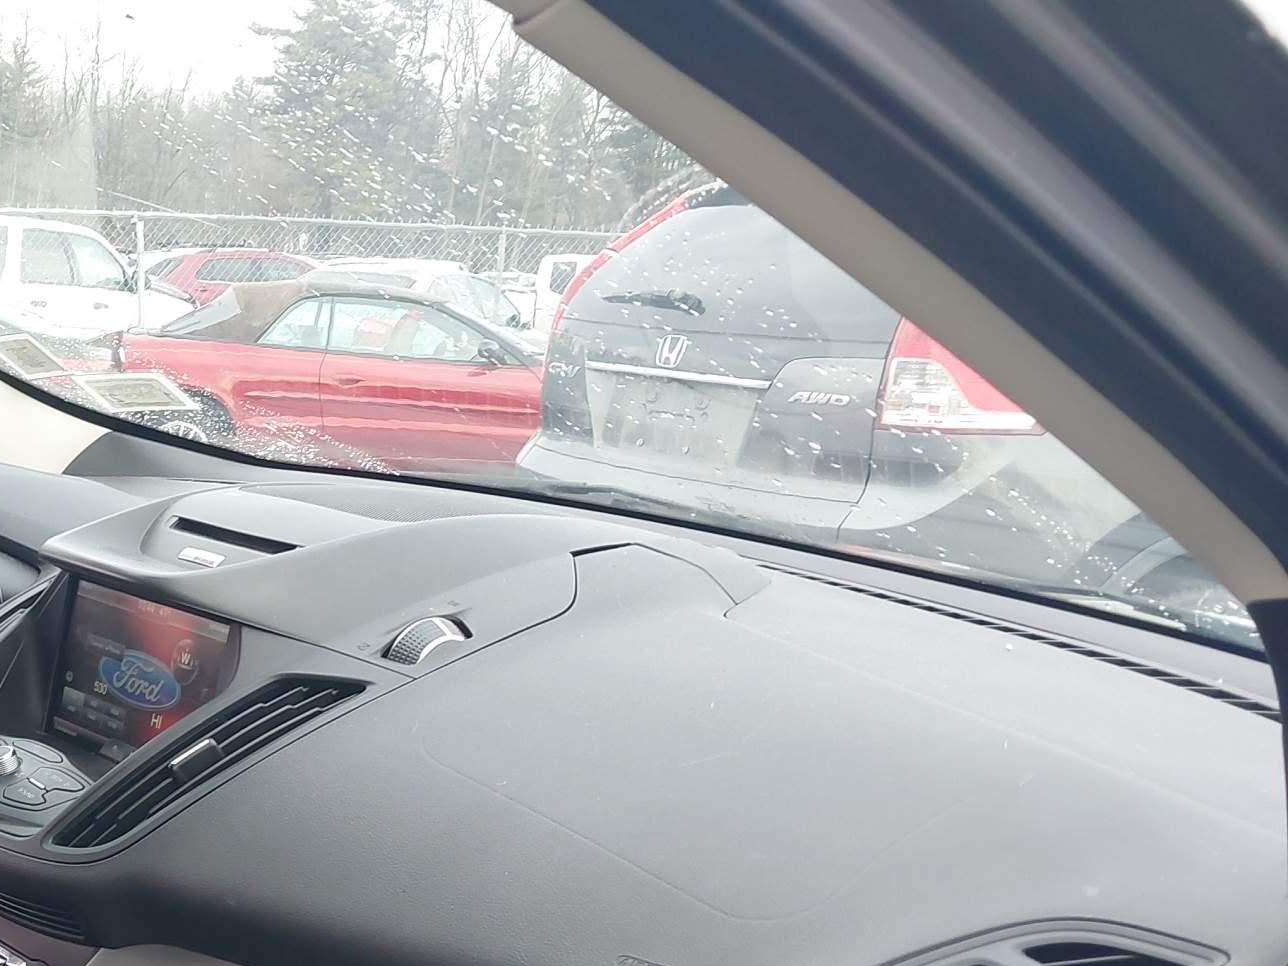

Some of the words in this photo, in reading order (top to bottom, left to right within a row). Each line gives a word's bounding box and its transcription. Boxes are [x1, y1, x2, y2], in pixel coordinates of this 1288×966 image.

[788, 391, 851, 406] AWD
[113, 656, 165, 702] Ford
[150, 712, 163, 729] HI
